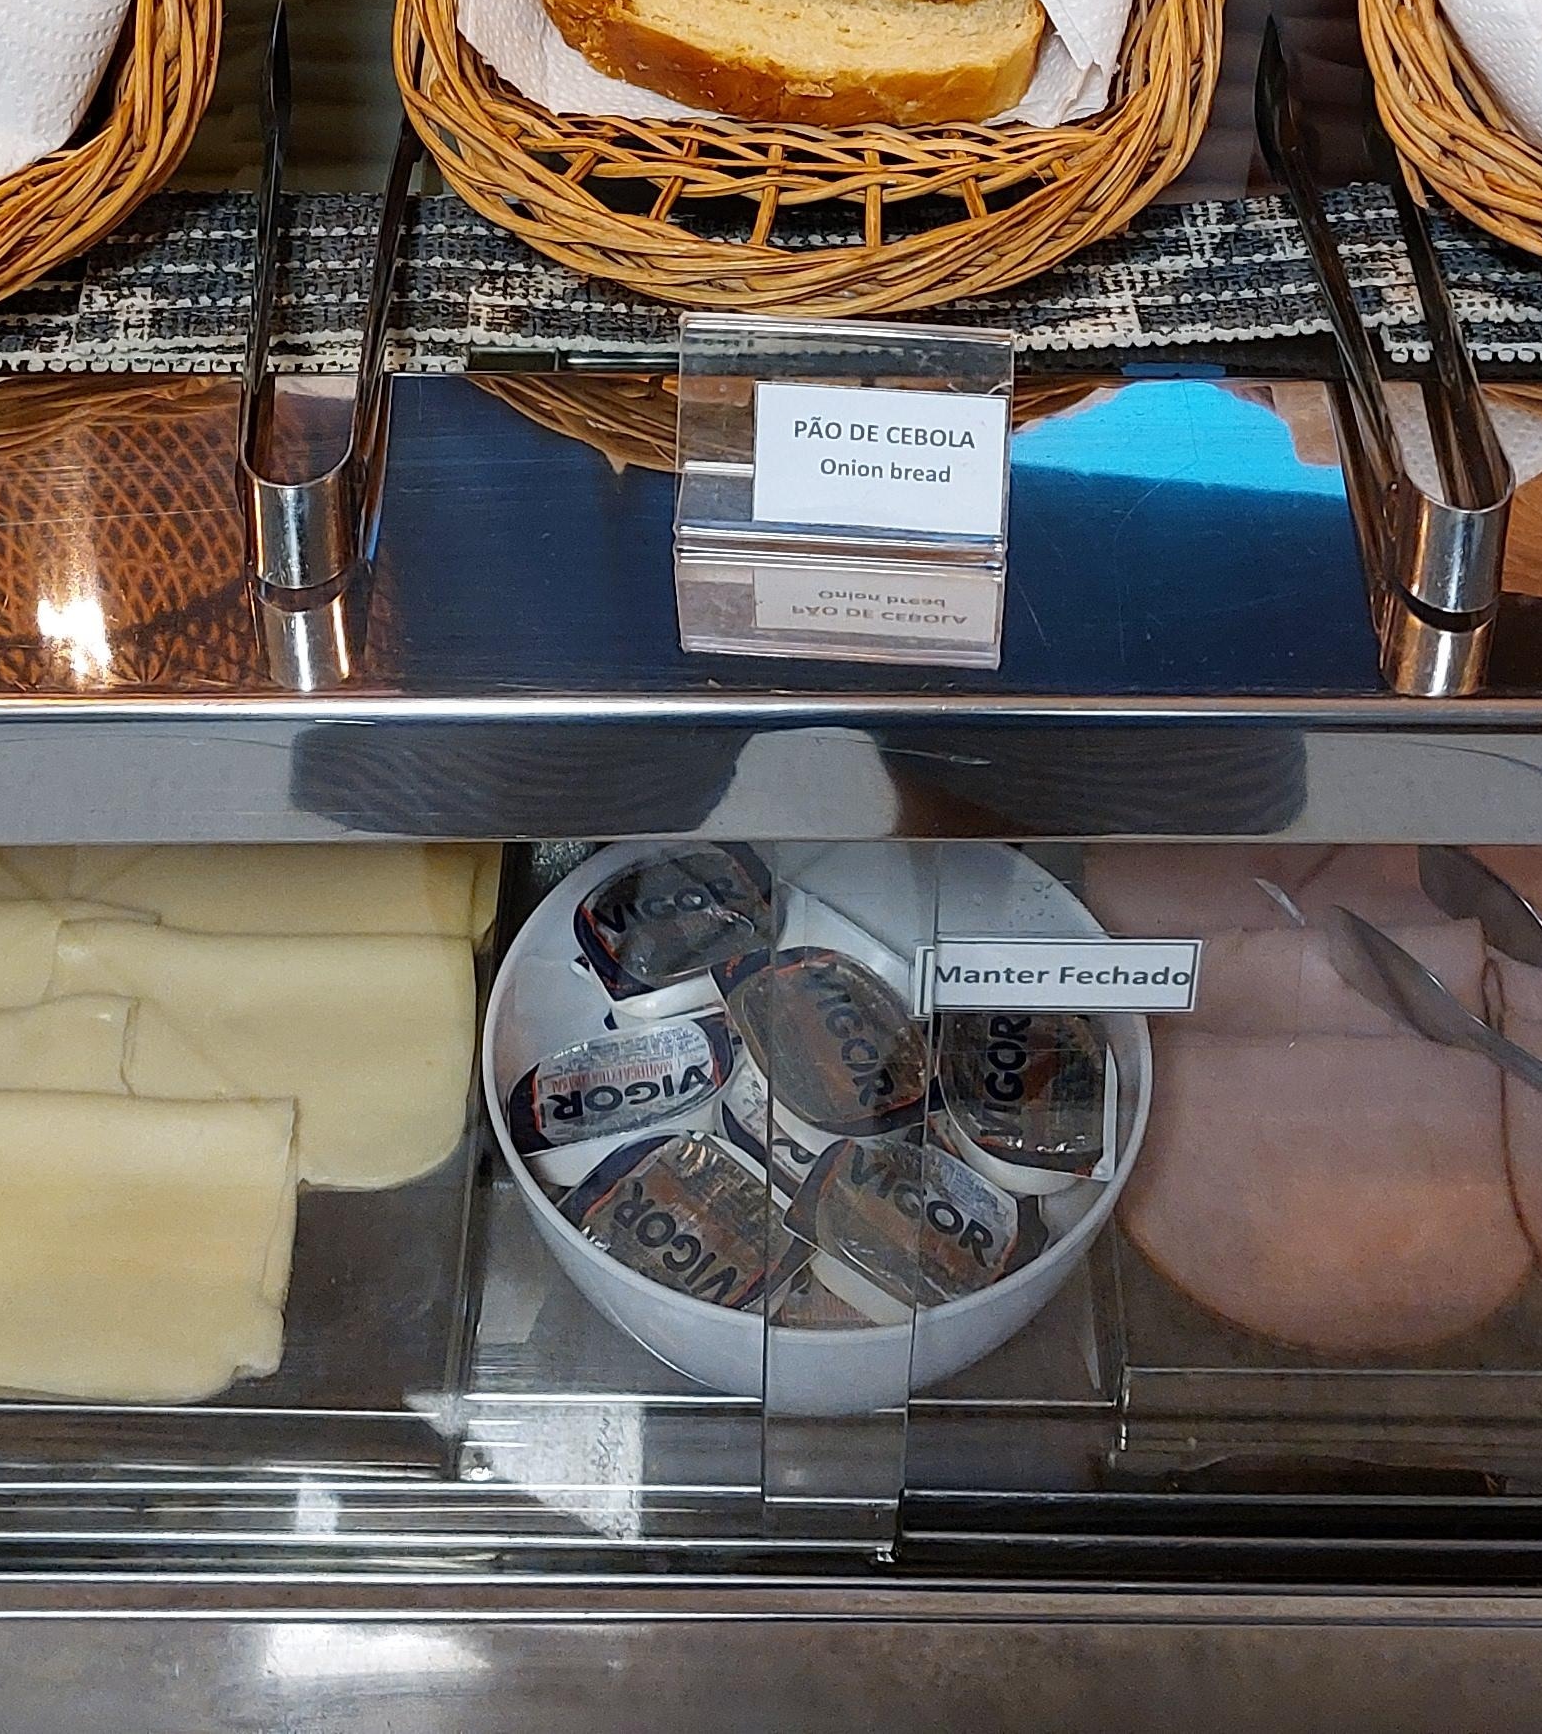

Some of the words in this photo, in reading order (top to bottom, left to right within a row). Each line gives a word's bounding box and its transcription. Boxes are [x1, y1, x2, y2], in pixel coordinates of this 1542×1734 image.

[794, 416, 841, 440] PÃO
[849, 423, 879, 443] DE
[886, 426, 975, 449] CEBOLA
[820, 458, 883, 480] Onion
[890, 463, 951, 483] bread
[591, 877, 748, 933] VIGOR
[935, 965, 1050, 984] Manter
[1059, 966, 1191, 986] Fechado
[802, 959, 895, 1108] VIGOR
[547, 1067, 713, 1120] VIGOR
[979, 1015, 1033, 1136] VIGOR
[850, 1143, 995, 1268] VIGOR
[613, 1182, 739, 1301] VIGOR
